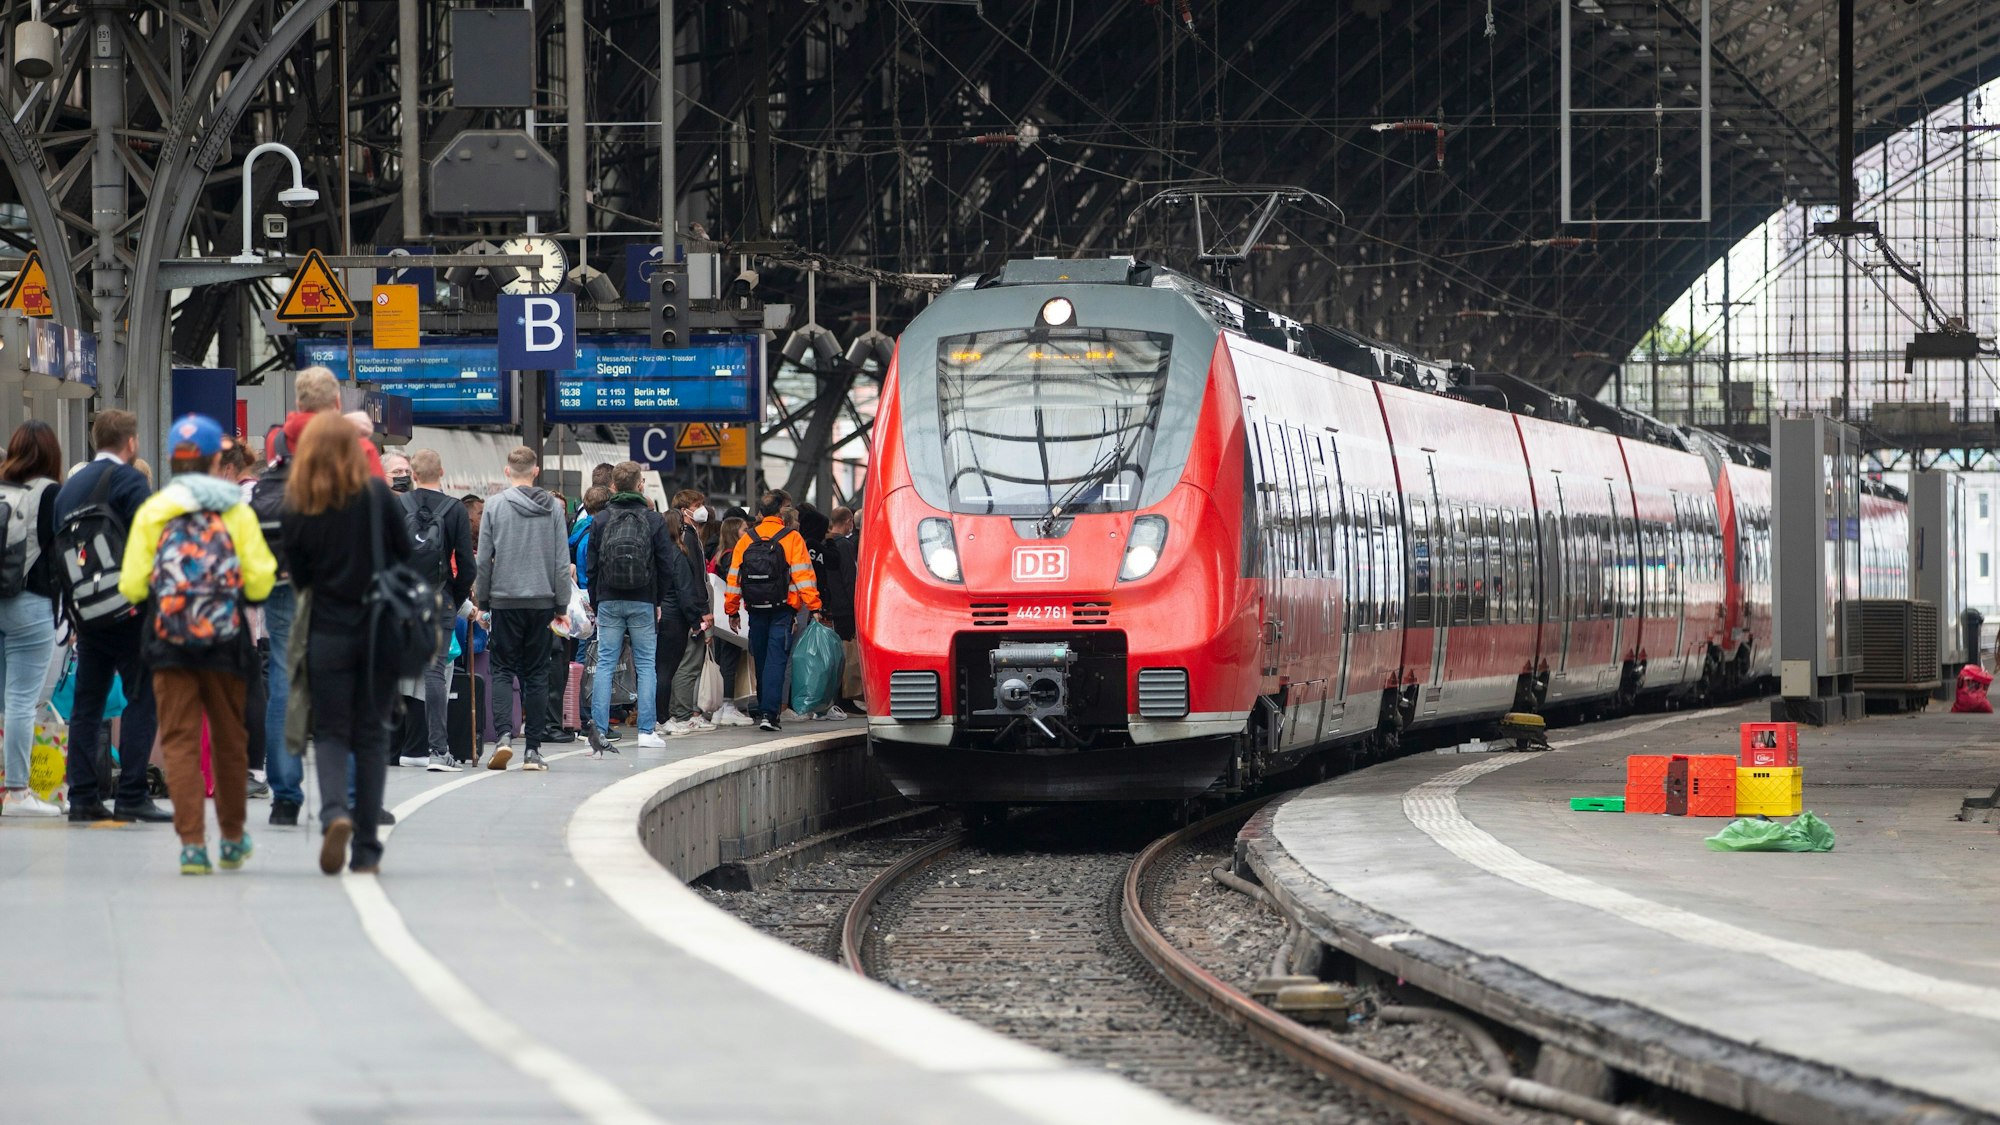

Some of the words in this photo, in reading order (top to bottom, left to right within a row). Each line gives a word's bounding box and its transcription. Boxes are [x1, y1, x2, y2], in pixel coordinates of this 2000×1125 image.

[524, 298, 564, 352] B
[312, 352, 334, 360] 16:25
[597, 364, 631, 376] Siegen
[642, 428, 667, 462] C
[1020, 552, 1060, 576] DB
[1016, 606, 1041, 619] 442
[1044, 606, 1066, 618] 761
